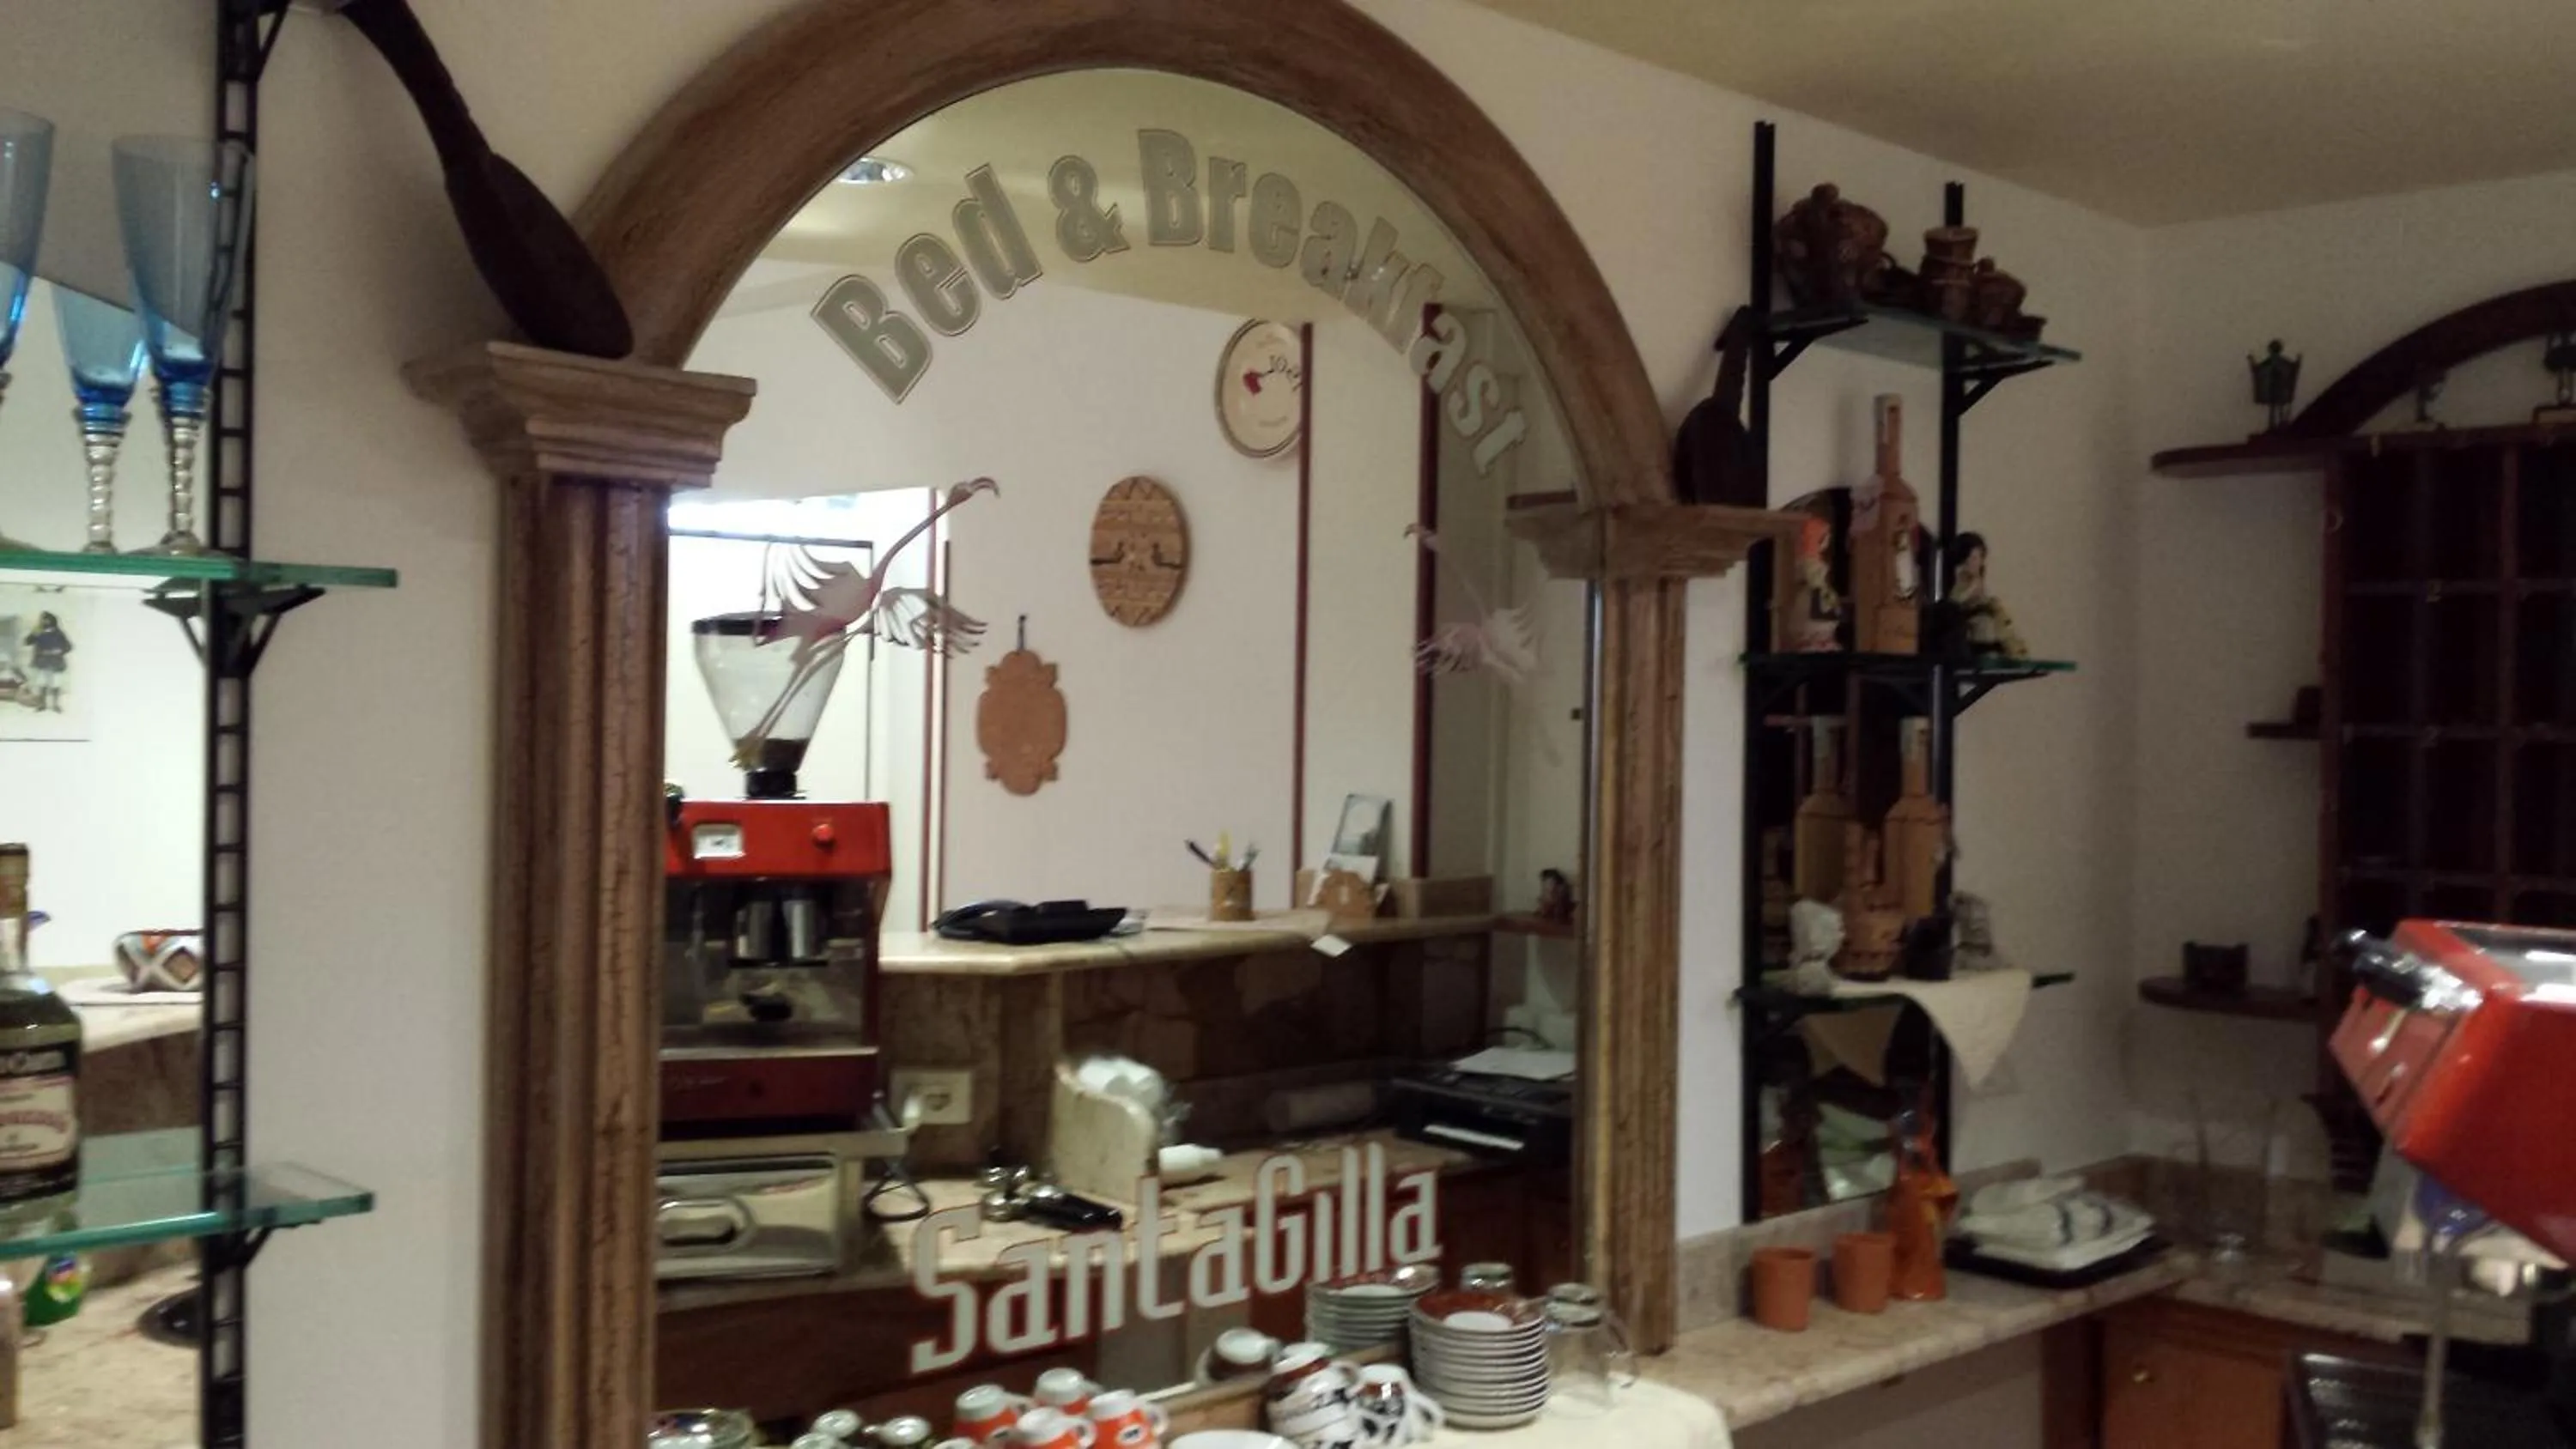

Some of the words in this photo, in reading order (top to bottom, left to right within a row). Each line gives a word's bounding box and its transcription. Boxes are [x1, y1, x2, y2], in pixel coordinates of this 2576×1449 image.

[810, 162, 1044, 404] Bed
[1047, 154, 1130, 263] &
[1136, 128, 1529, 478] Breakfast
[910, 1141, 1443, 1374] SantaGilla
